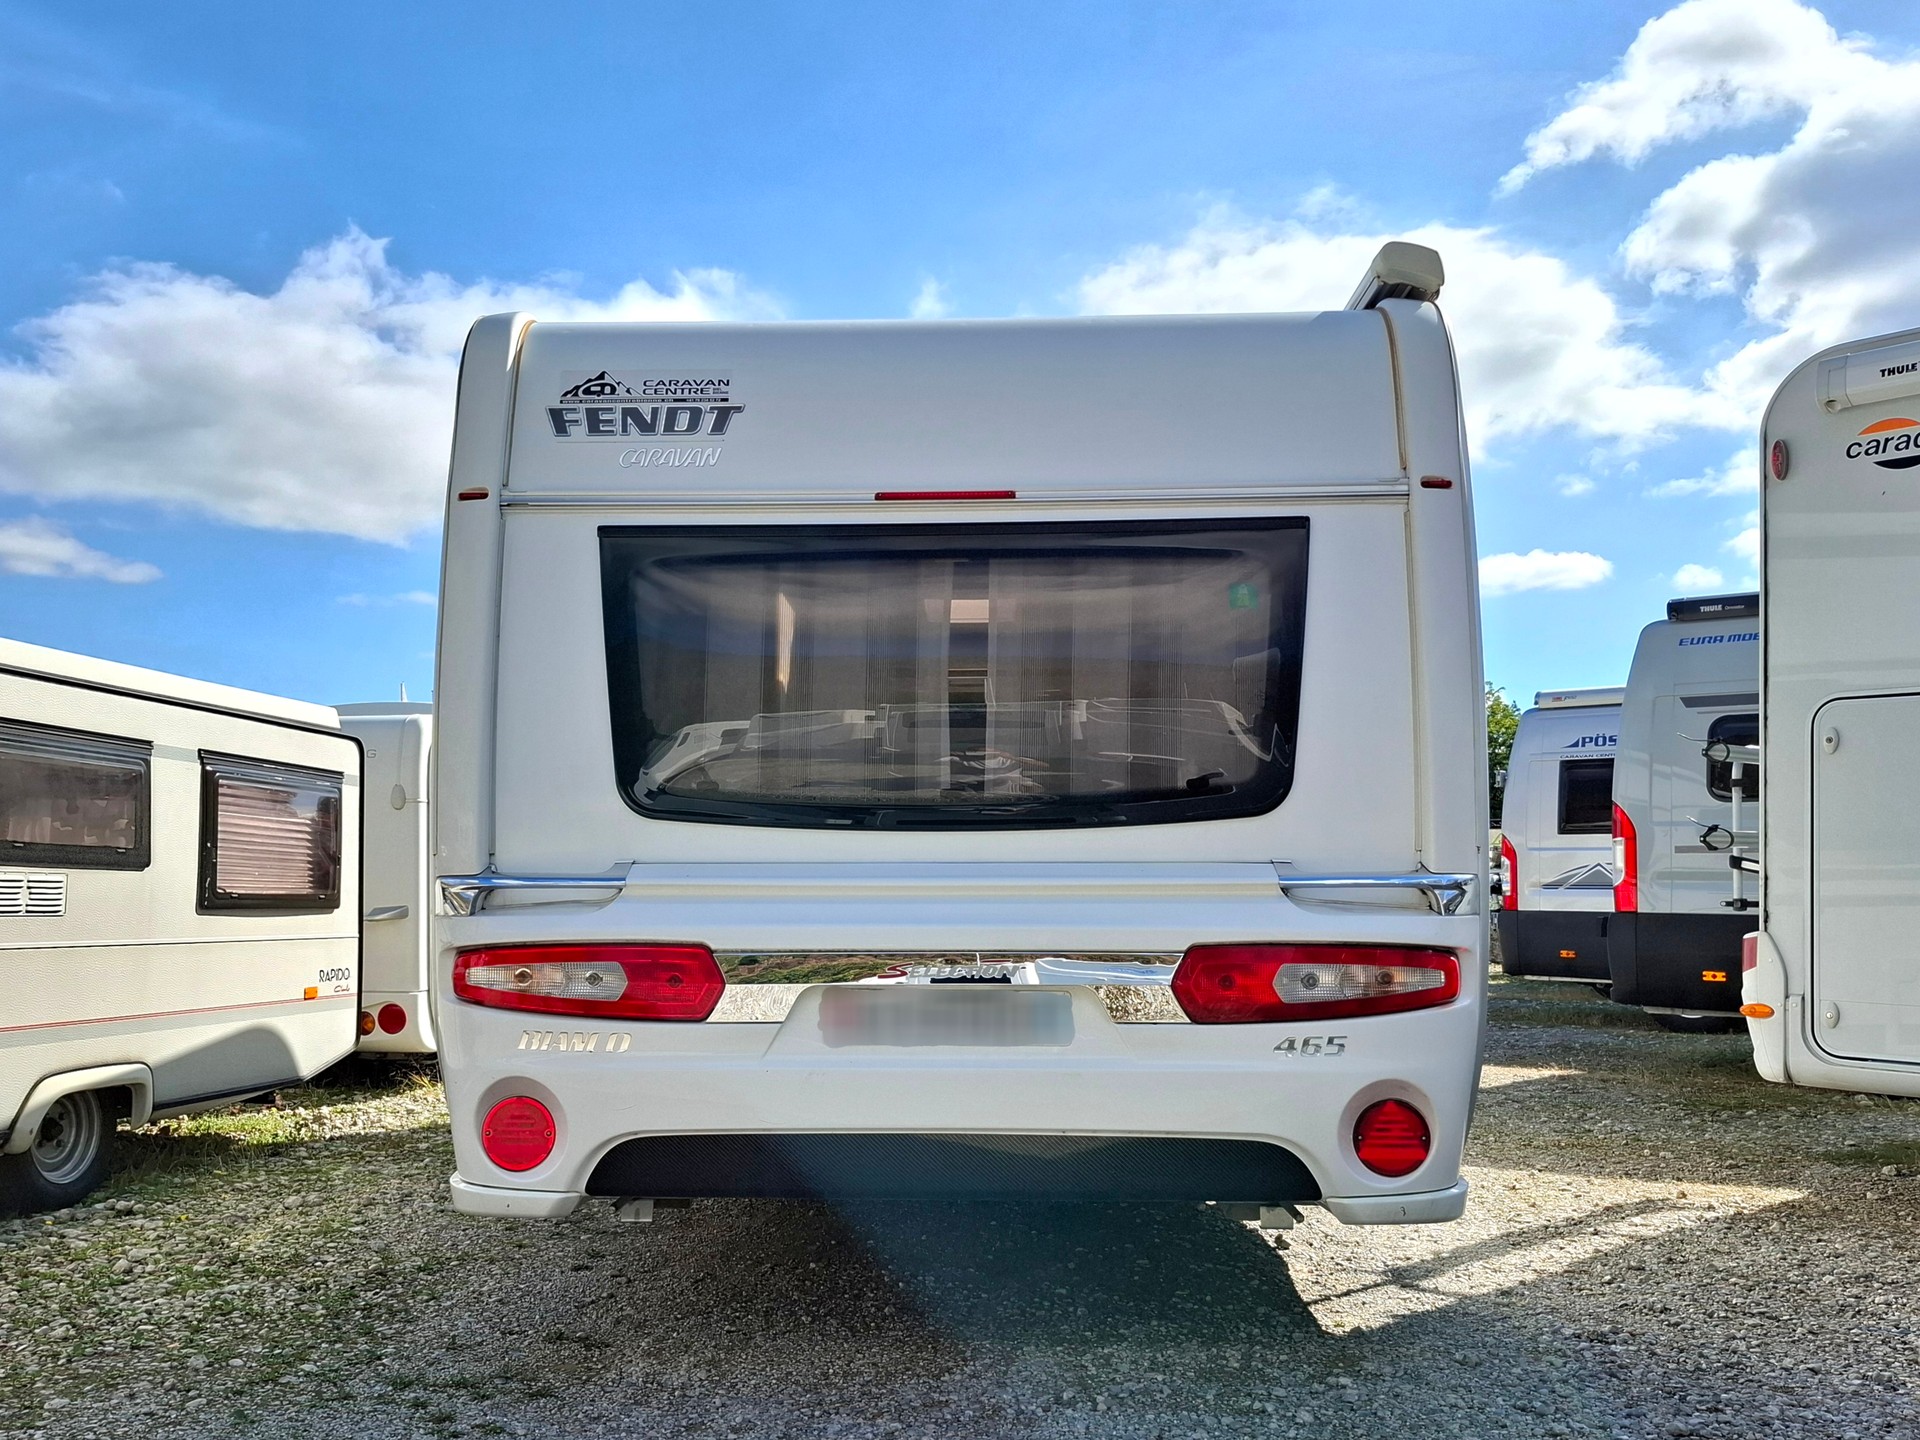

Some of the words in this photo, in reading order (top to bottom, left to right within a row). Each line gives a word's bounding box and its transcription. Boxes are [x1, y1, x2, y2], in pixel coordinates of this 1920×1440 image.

[1879, 362, 1918, 378] THULE
[643, 379, 730, 388] CARAVAN
[643, 387, 711, 396] CENTRE
[545, 403, 746, 437] FENDT
[619, 447, 723, 469] CARAVAN
[1699, 604, 1723, 613] THULE
[1678, 635, 1725, 647] EURA
[319, 967, 351, 983] RAPIDO
[1273, 1035, 1347, 1057] 465
